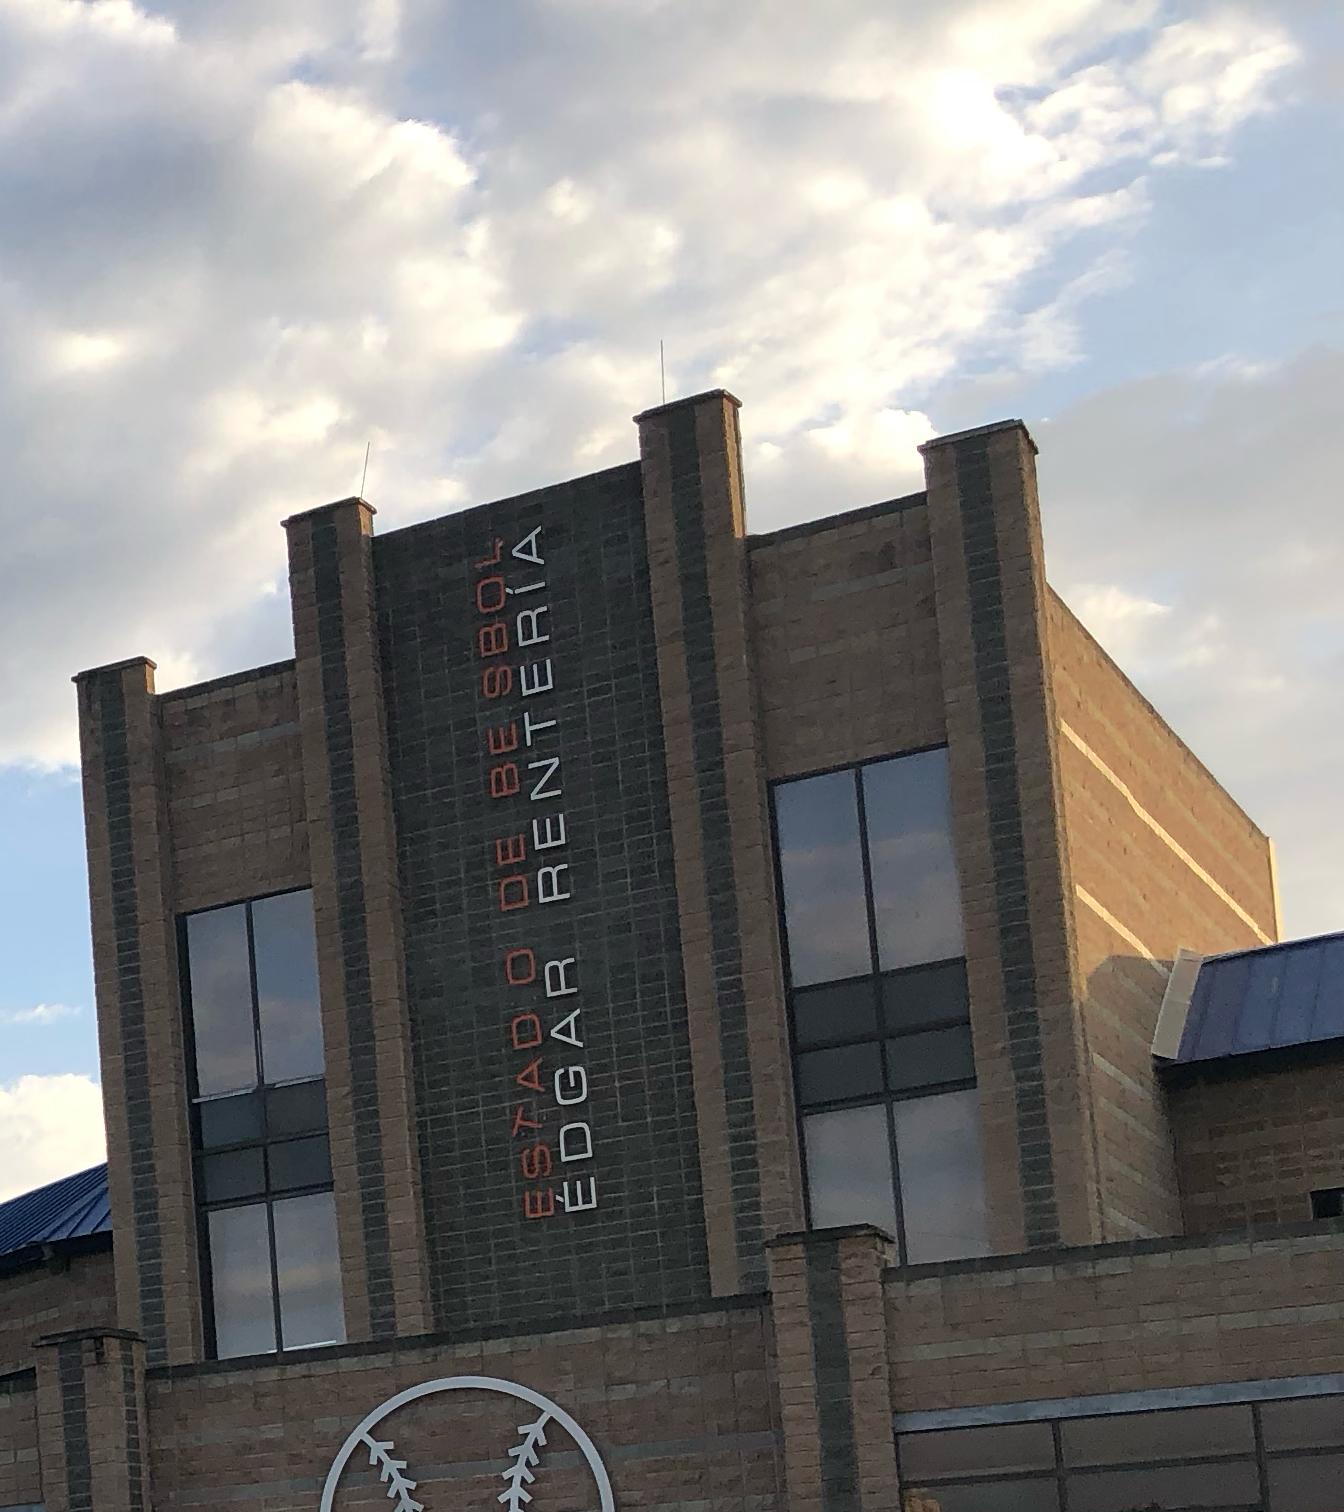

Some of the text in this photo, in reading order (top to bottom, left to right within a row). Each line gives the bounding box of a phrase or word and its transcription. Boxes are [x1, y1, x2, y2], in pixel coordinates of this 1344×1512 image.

[496, 833, 529, 912] DE
[506, 525, 598, 1213] ÉDGAR RENTERÍA
[506, 948, 555, 1218] ESTADO
